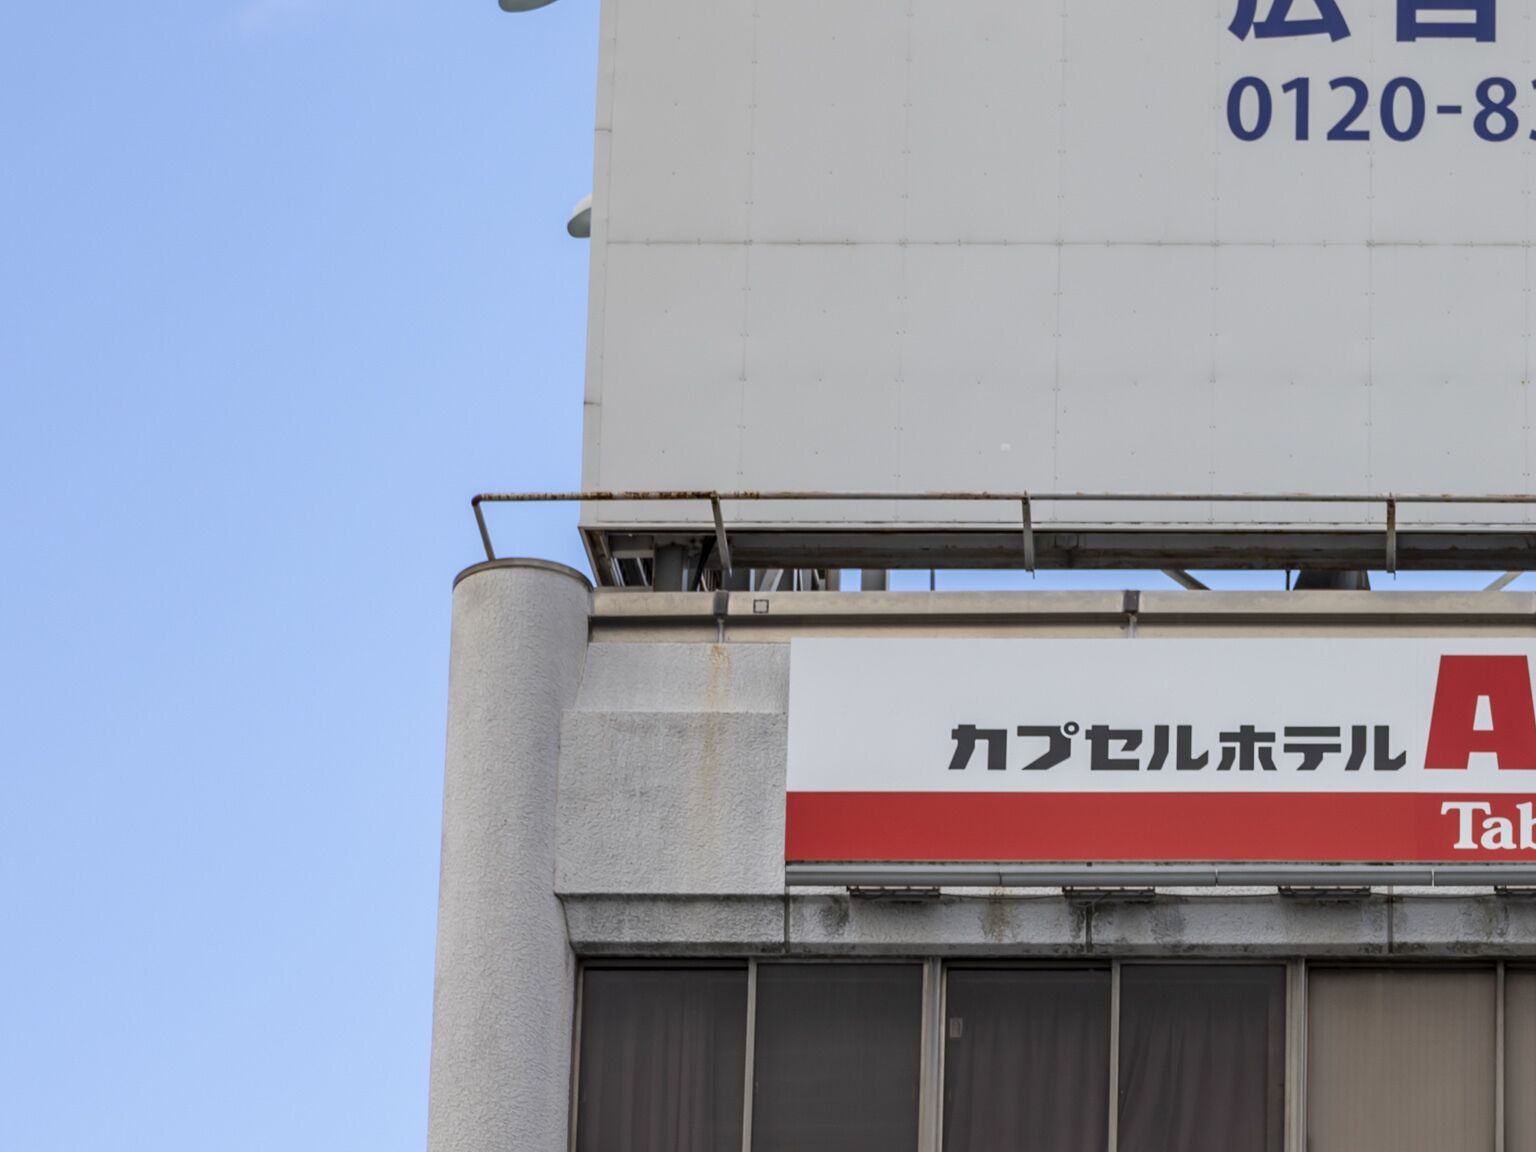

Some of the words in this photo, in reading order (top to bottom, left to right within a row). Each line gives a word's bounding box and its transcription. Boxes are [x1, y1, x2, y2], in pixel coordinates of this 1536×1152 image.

[948, 720, 1407, 771] カプセルホテル
